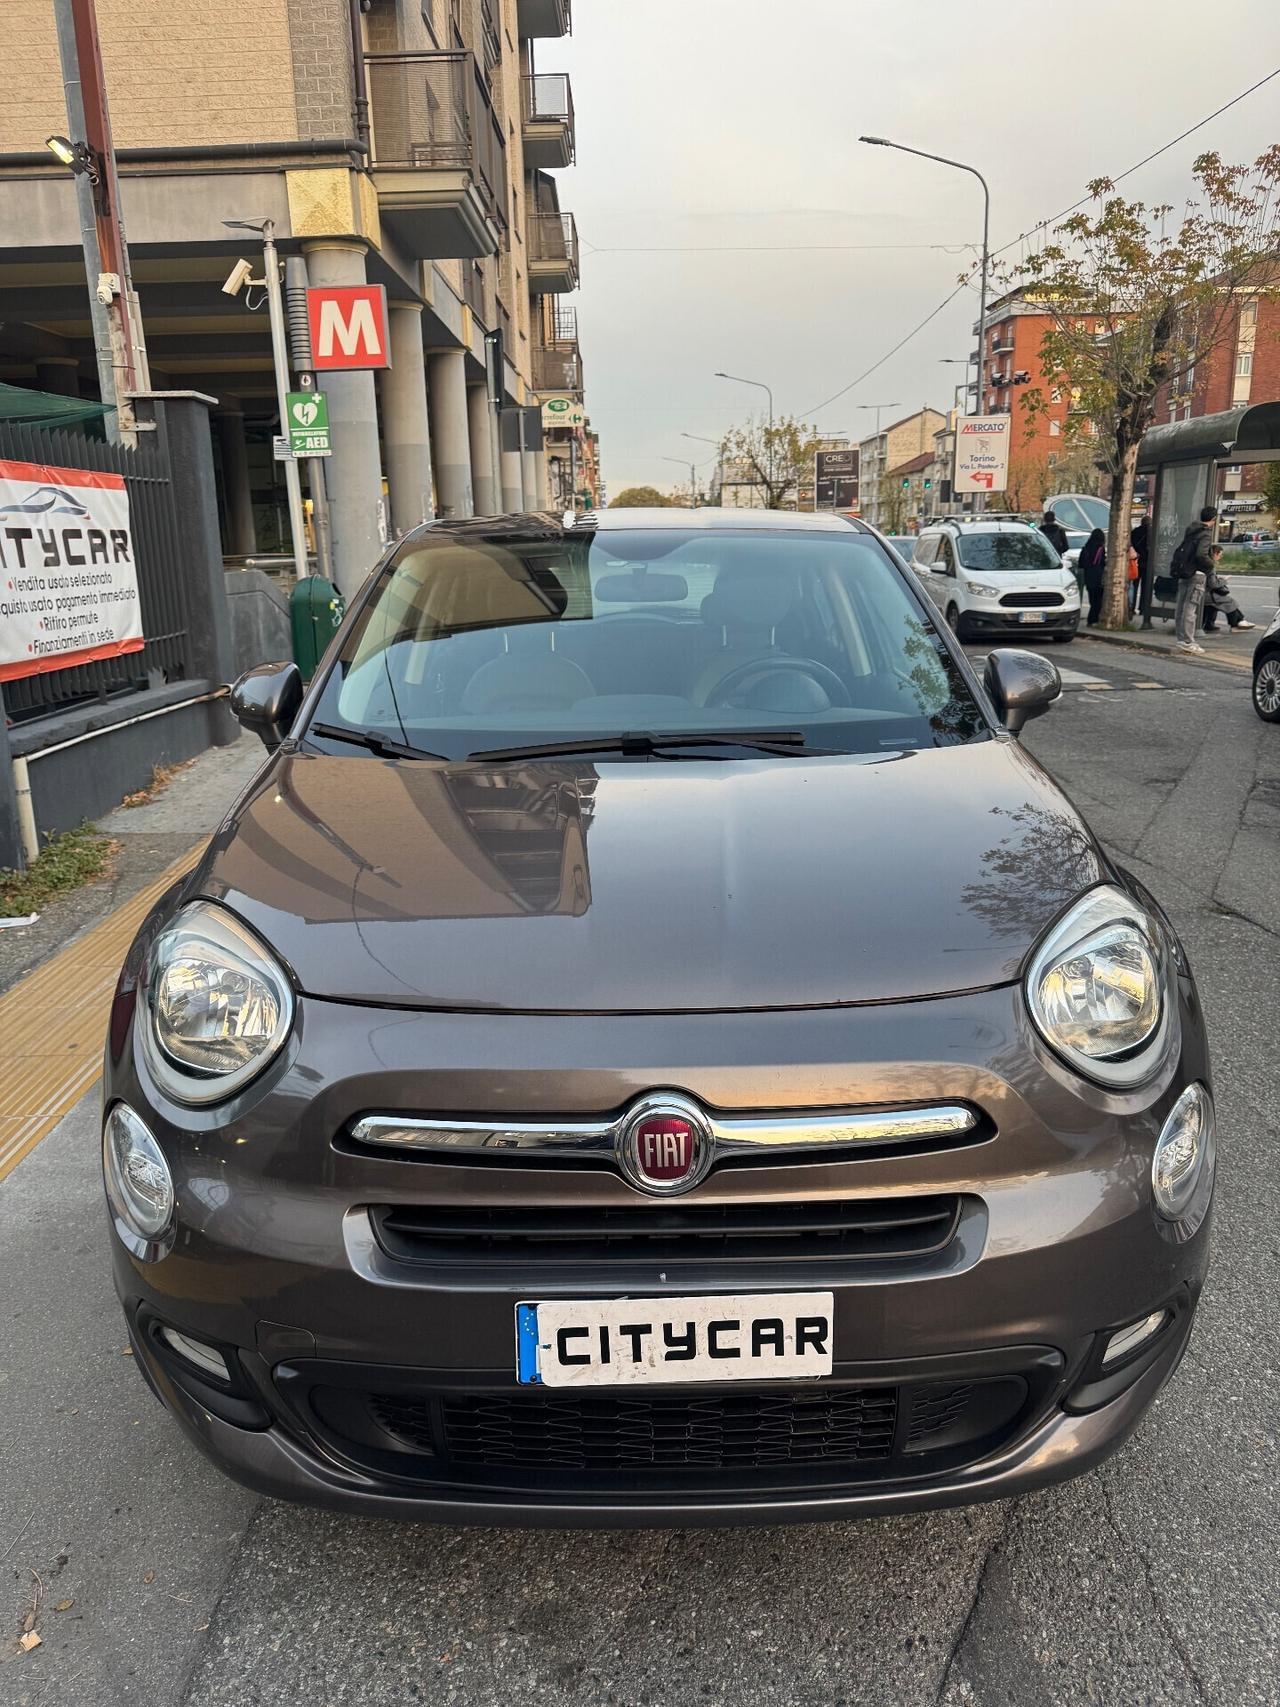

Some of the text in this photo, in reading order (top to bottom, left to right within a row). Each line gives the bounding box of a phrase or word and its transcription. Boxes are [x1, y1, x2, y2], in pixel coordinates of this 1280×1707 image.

[318, 299, 381, 357] M
[306, 437, 328, 448] AED
[970, 454, 996, 462] Torino
[11, 571, 112, 591] Vendita usato selezionato
[0, 588, 136, 618] quisto usato pagamento immediato
[43, 611, 98, 631] Ritiro permute
[34, 627, 114, 654] Finanziamenti in sede
[644, 1132, 688, 1168] FIAT
[557, 1317, 828, 1365] CITYCAR
